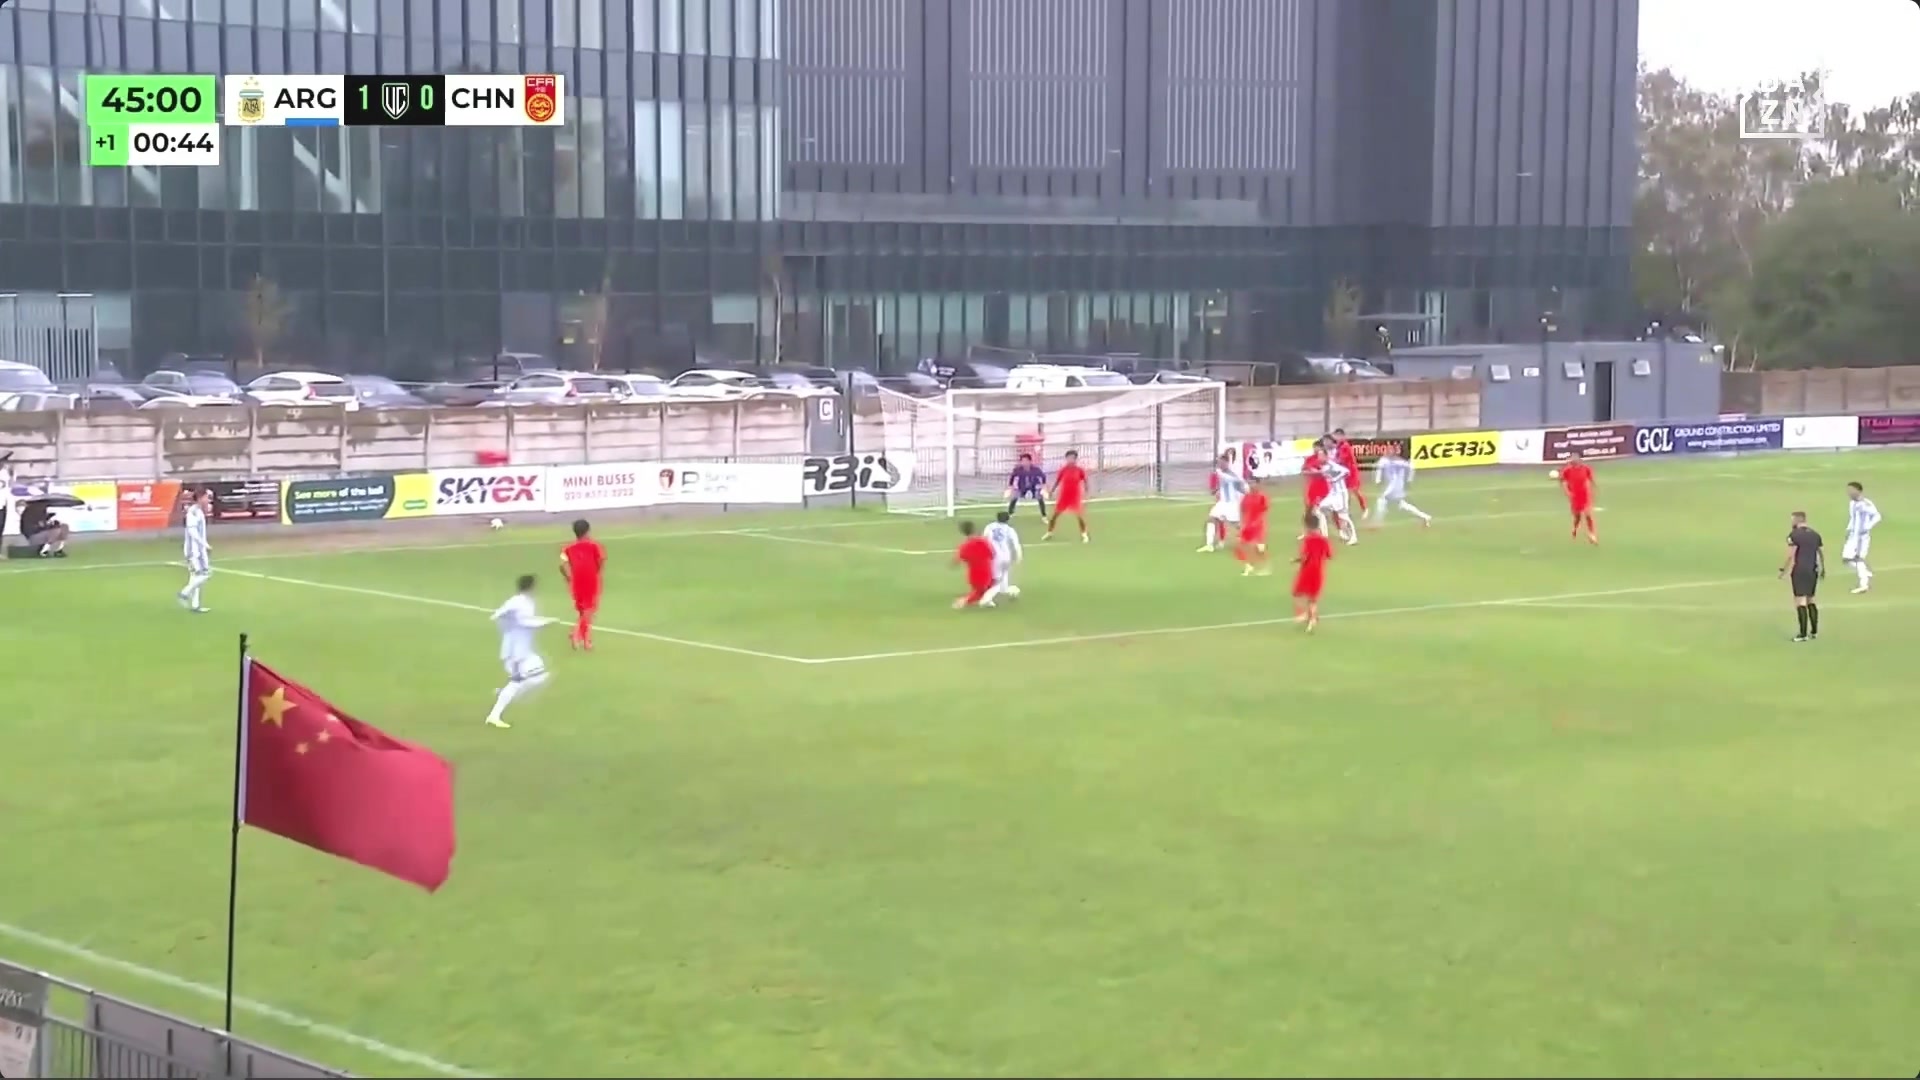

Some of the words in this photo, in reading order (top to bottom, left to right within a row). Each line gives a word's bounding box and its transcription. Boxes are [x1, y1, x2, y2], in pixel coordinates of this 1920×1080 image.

[821, 400, 832, 417] C
[1635, 427, 1674, 454] GCL
[563, 475, 593, 488] MINI
[597, 472, 636, 486] BUSES
[313, 489, 337, 499] more
